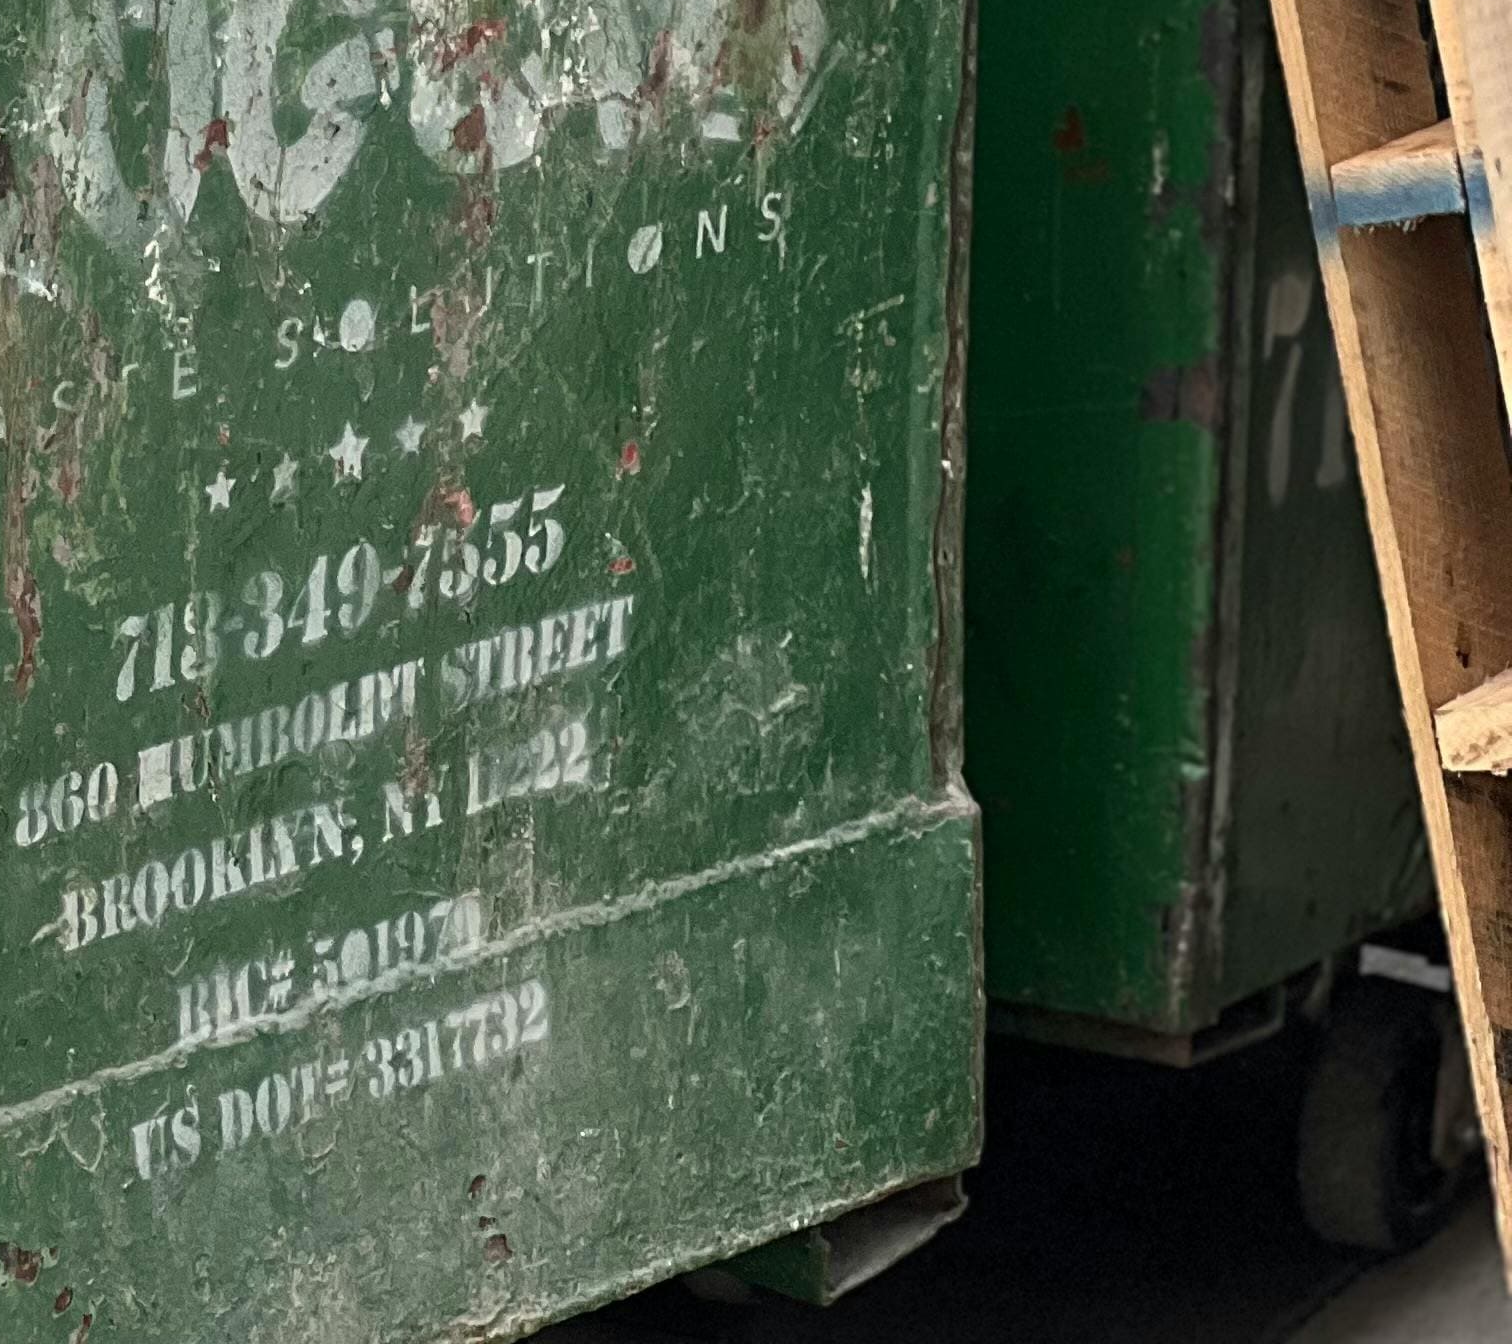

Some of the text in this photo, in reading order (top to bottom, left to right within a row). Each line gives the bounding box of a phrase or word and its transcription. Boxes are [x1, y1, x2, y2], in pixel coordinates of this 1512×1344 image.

[115, 484, 566, 702] 718-349-7555
[15, 761, 119, 847] 860
[441, 594, 635, 714] STREET
[132, 1106, 203, 1181] US
[366, 979, 550, 1100] 3317732
